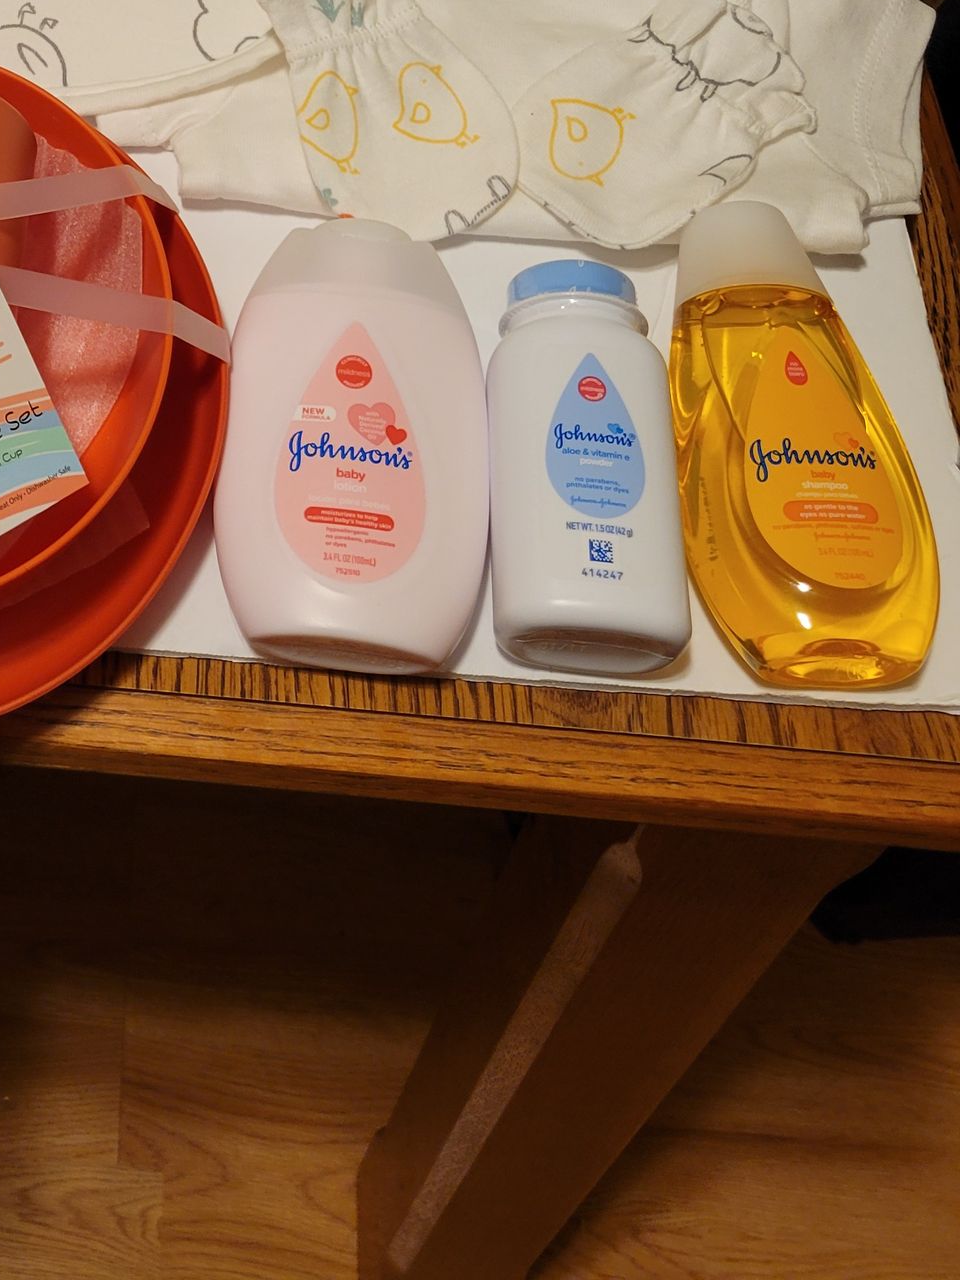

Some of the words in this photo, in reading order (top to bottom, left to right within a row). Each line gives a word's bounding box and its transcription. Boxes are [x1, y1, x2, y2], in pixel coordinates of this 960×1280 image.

[4, 400, 44, 431] Set
[301, 407, 325, 415] NEW
[554, 423, 634, 449] Johnson's
[2, 448, 23, 463] Cup
[288, 430, 413, 472] Johnson's
[561, 447, 581, 455] aloe
[582, 448, 589, 456] &
[591, 449, 623, 459] vitamin
[749, 438, 876, 482] Johnson's
[336, 467, 366, 482] baby
[810, 469, 836, 481] baby
[9, 493, 23, 506] Only
[25, 472, 58, 495] Dishwasher
[58, 464, 71, 476] Safe
[334, 479, 368, 493] lotion
[801, 480, 849, 491] shampoo
[566, 521, 580, 530] NET
[605, 524, 615, 534] OZ
[581, 567, 624, 581] 414247
